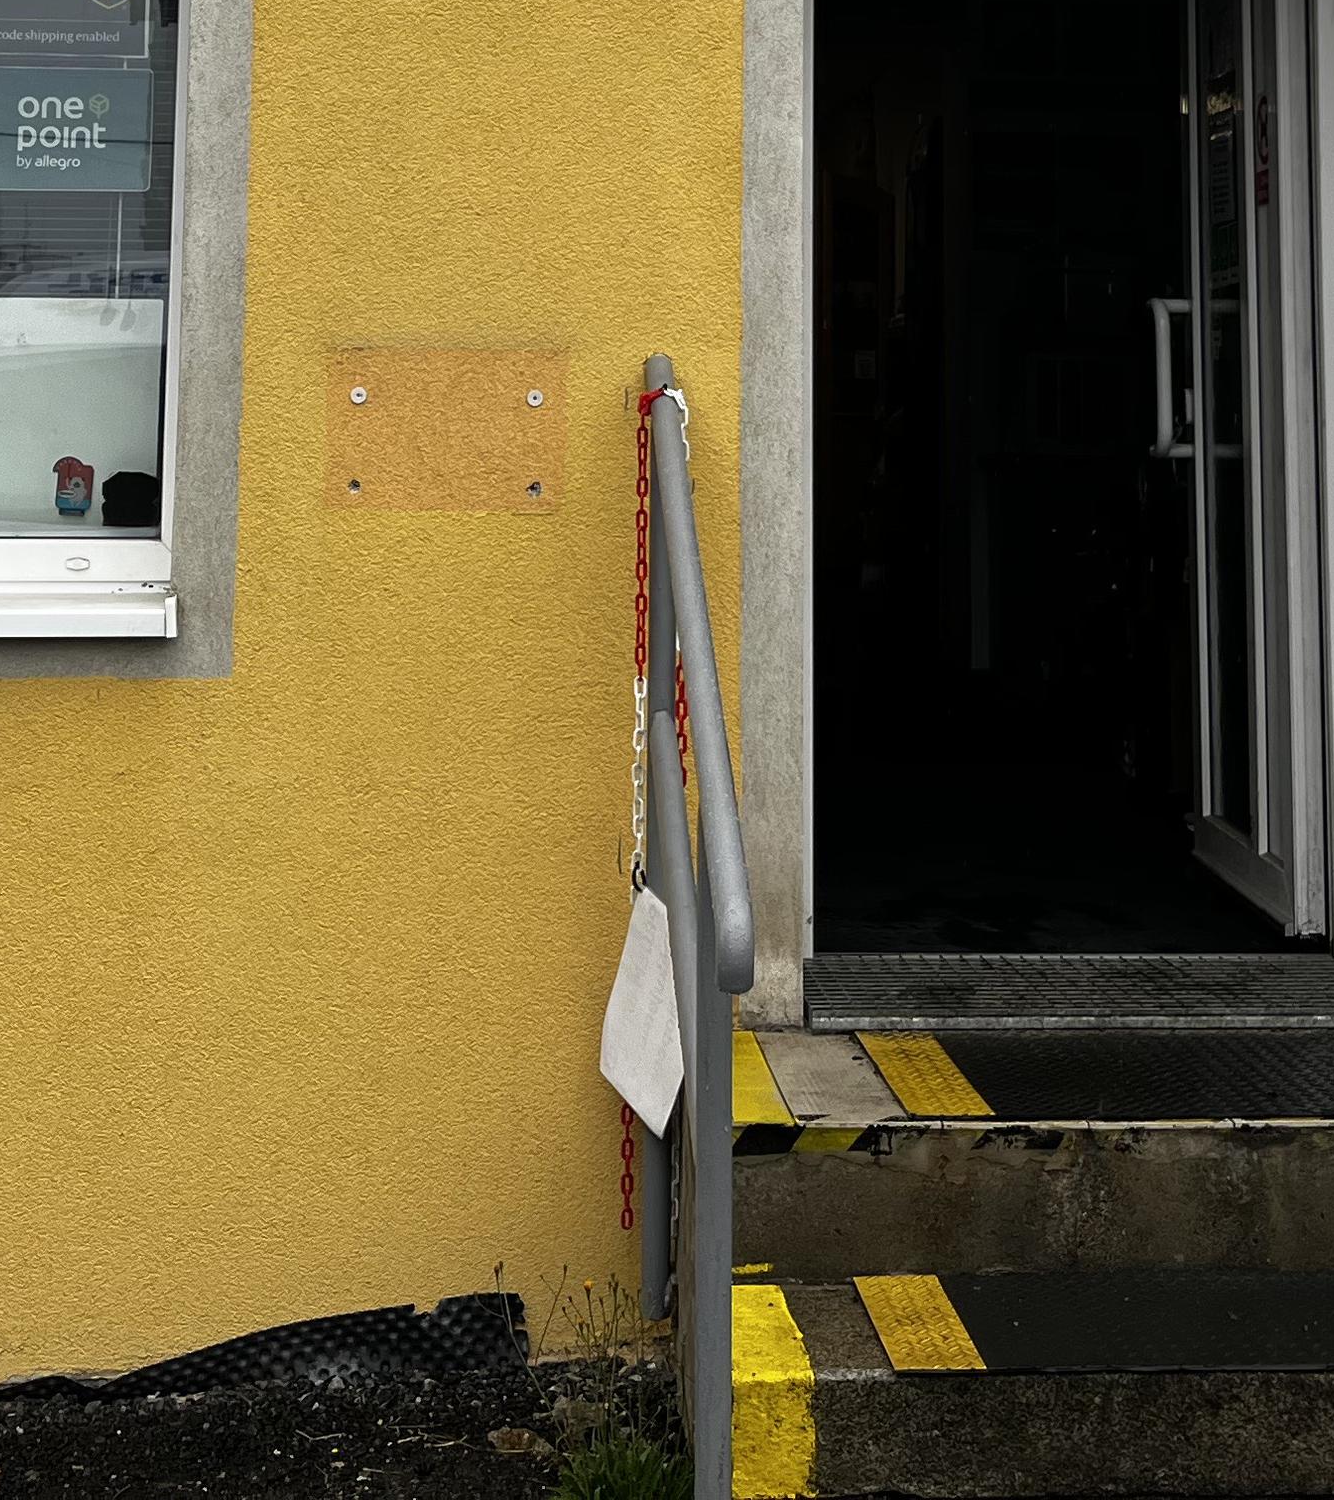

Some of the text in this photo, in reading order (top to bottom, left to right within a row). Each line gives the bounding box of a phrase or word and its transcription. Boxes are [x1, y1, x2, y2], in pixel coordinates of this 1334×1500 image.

[25, 28, 74, 44] shipping
[76, 30, 120, 43] enabled
[17, 96, 84, 119] one
[16, 122, 106, 152] point
[16, 155, 81, 171] by allegro
